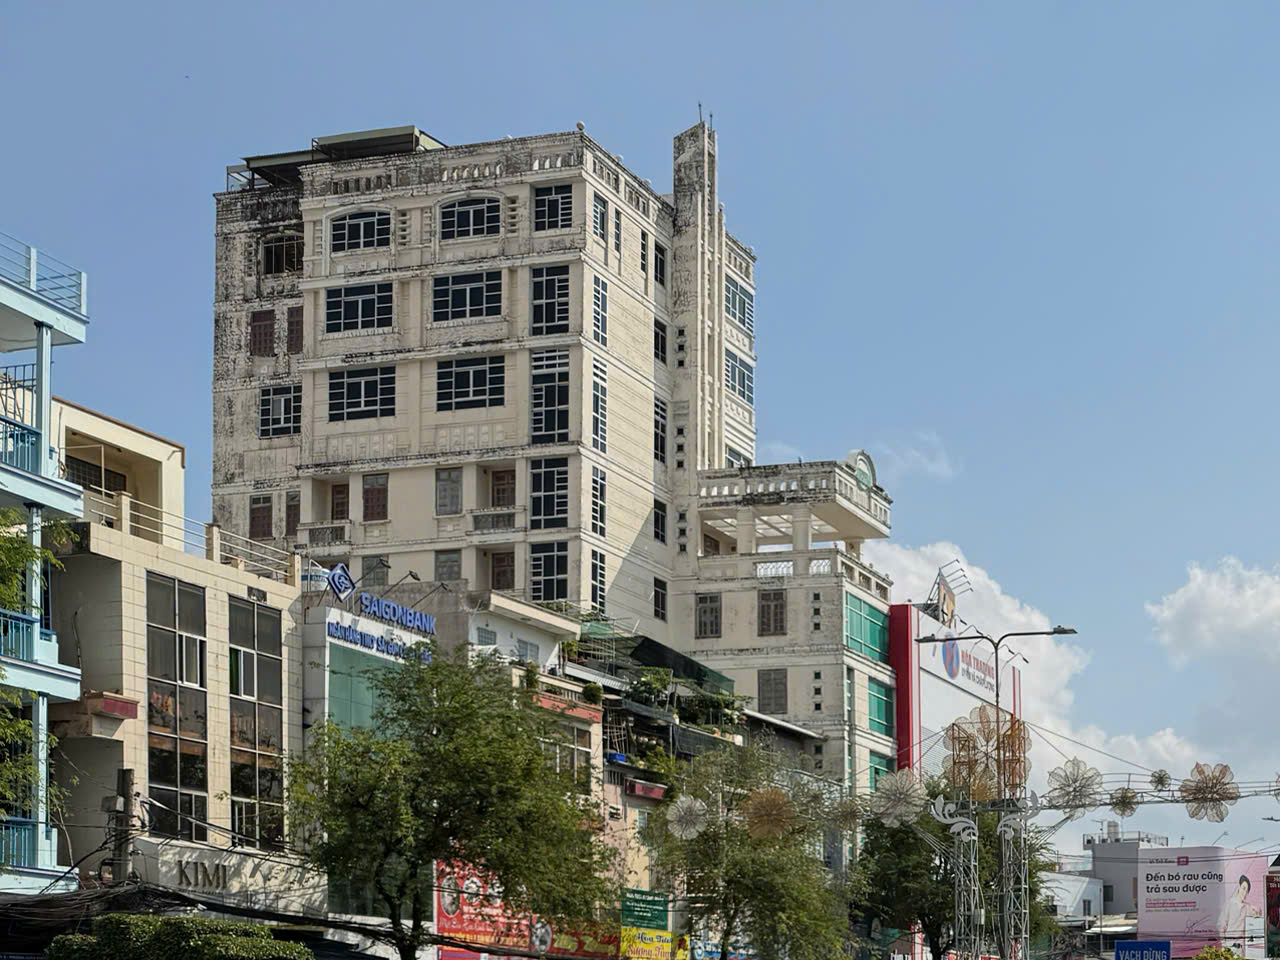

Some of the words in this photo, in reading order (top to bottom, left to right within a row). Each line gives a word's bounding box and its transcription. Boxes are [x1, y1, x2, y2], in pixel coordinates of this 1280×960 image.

[360, 592, 436, 635] SAIGONBANK
[1145, 872, 1166, 882] Đến
[1167, 872, 1181, 881] bó
[1182, 873, 1200, 881] rau
[1201, 871, 1224, 883] cũng
[1146, 884, 1161, 894] trả
[1162, 885, 1181, 894] sau
[1182, 883, 1208, 895] được
